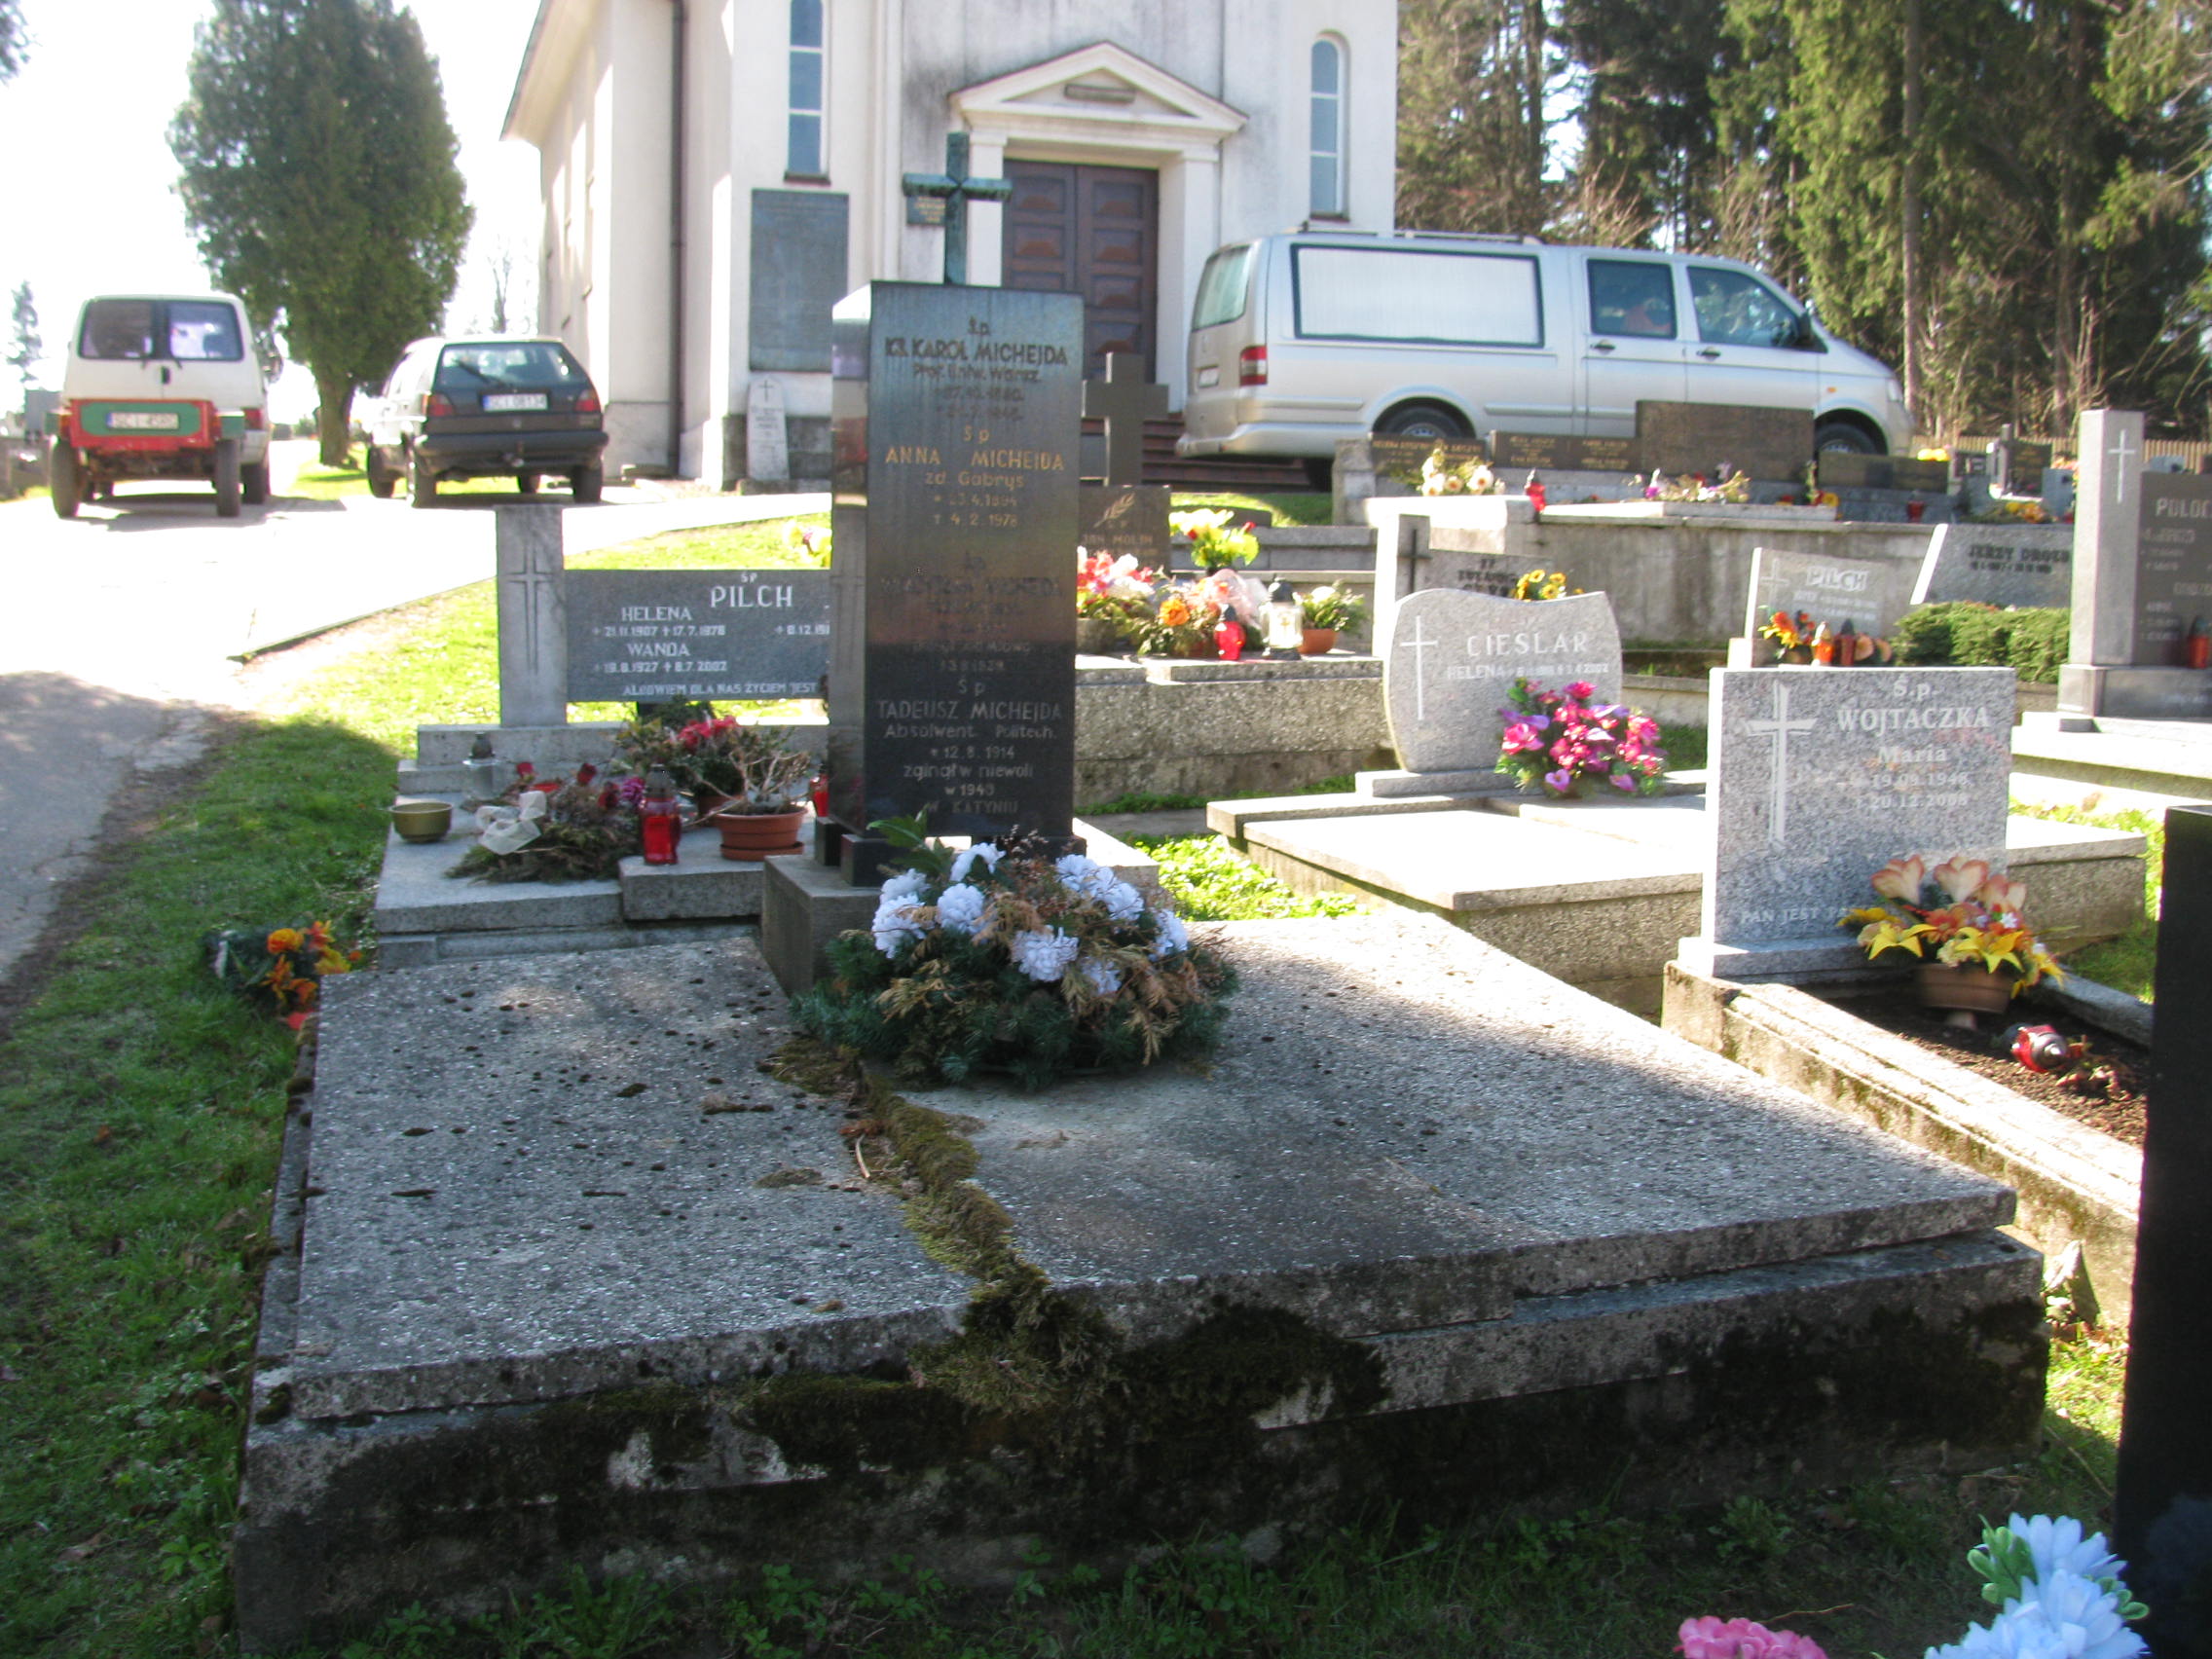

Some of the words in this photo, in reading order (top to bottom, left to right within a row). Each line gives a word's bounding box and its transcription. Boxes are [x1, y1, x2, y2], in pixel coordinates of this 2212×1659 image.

[911, 338, 969, 361] KAROL
[974, 342, 1068, 365] MICHEJDA
[885, 445, 941, 465] ANNA
[1806, 566, 1869, 592] PILCH
[711, 584, 793, 608] PILCH
[621, 606, 693, 621] HELENA
[626, 643, 691, 657] WANDA
[877, 700, 959, 719] TADEUSZ
[970, 701, 1063, 722] MICHEJDA
[1836, 706, 1991, 737] WOJTACZKA
[1877, 743, 1948, 764] Maria
